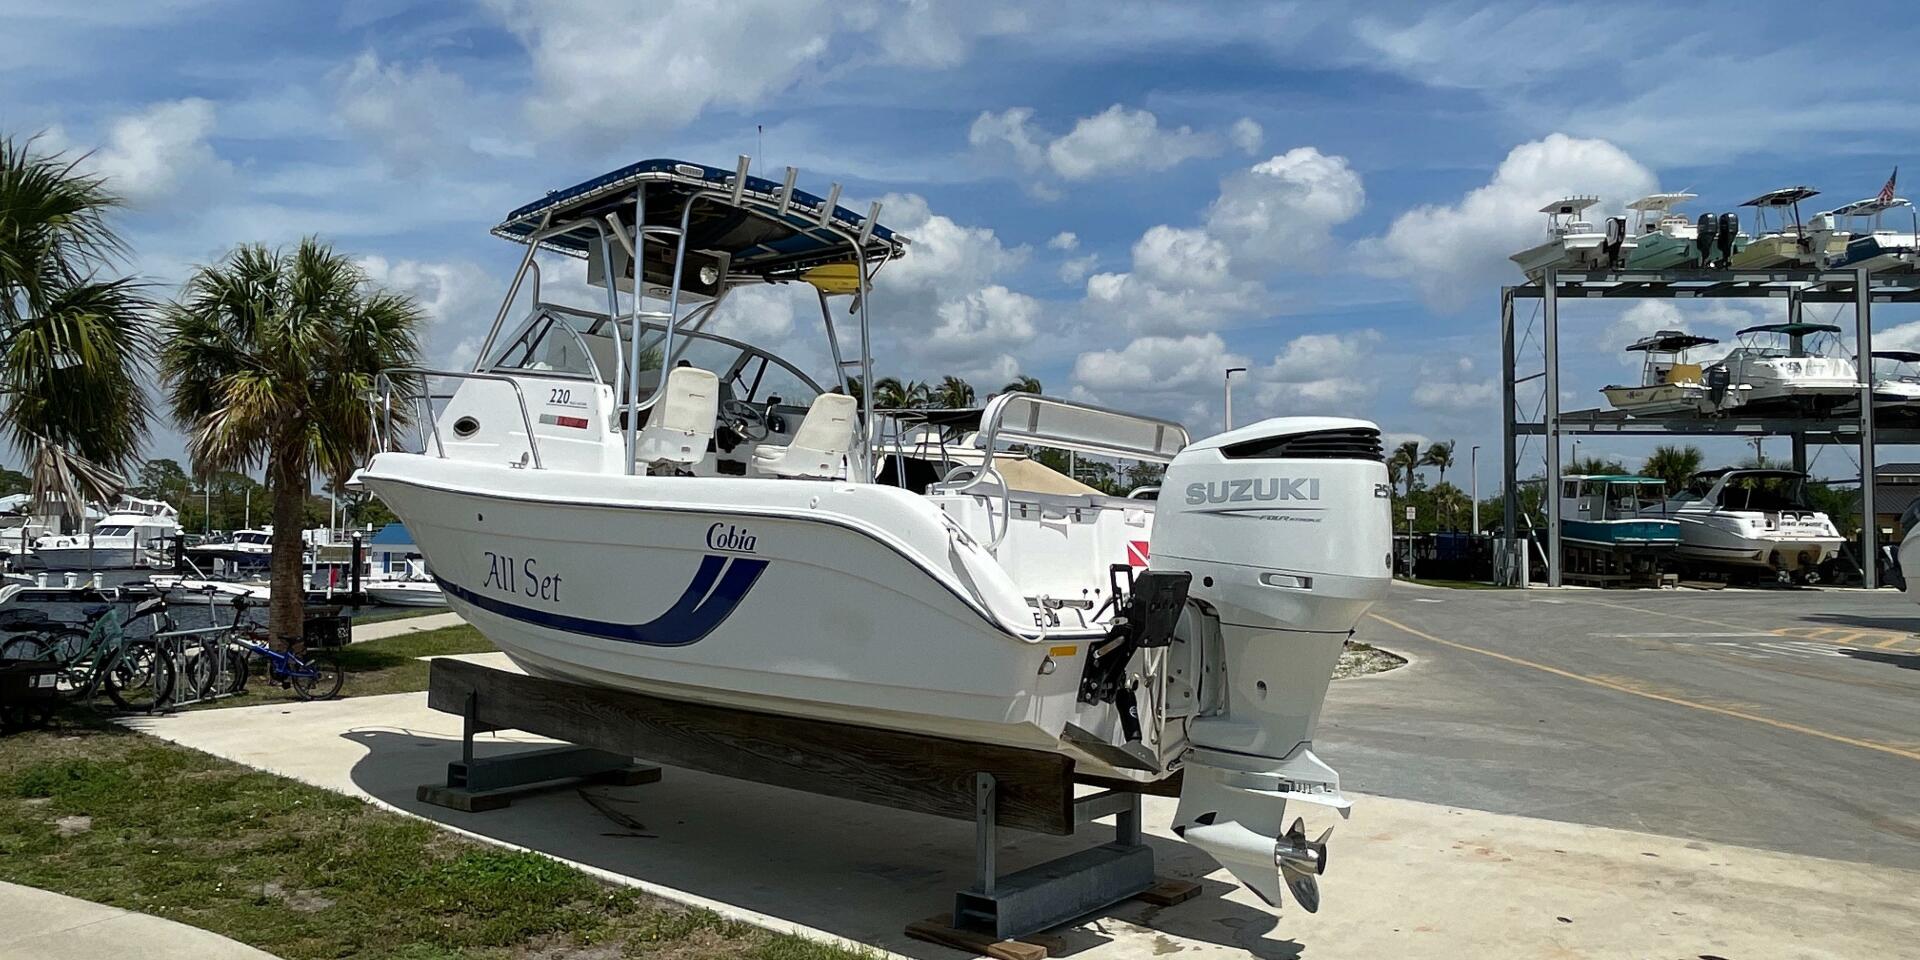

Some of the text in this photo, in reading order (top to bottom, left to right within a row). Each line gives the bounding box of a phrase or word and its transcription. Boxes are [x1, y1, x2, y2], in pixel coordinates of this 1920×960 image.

[549, 388, 571, 404] 220
[1185, 478, 1320, 505] SUZUKI
[706, 522, 757, 552] Cobia
[483, 552, 562, 602] All Set
